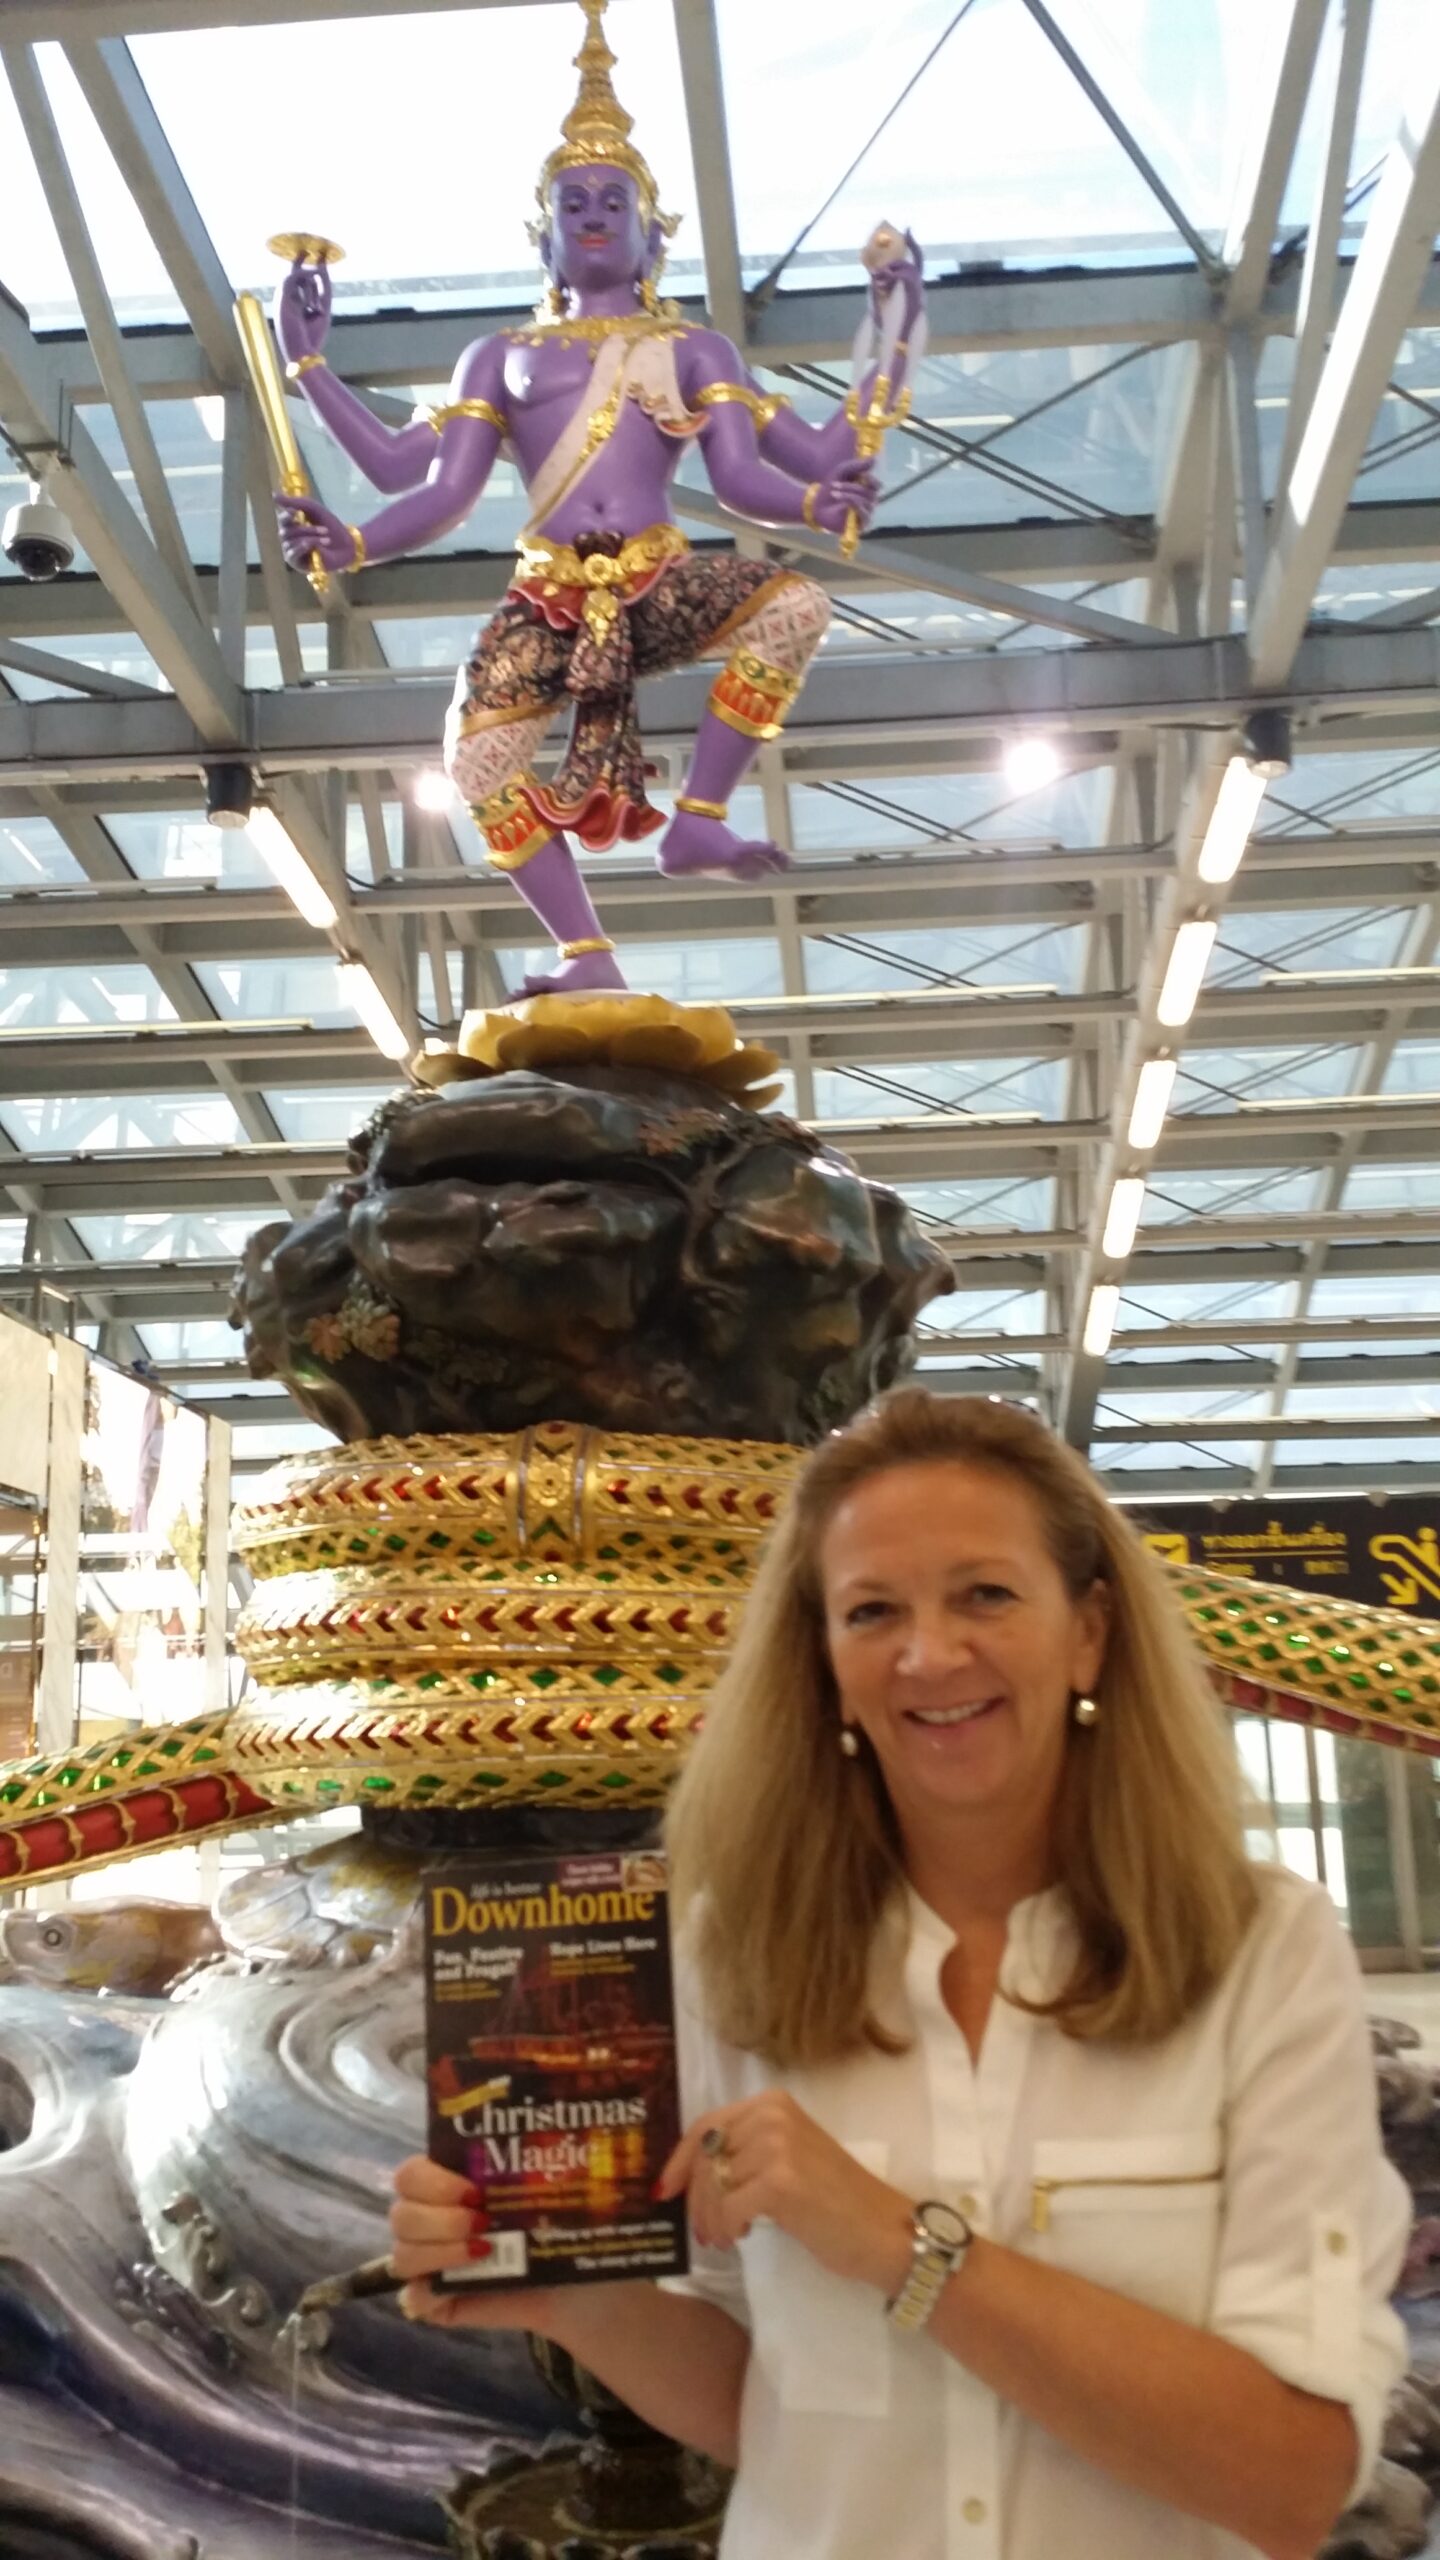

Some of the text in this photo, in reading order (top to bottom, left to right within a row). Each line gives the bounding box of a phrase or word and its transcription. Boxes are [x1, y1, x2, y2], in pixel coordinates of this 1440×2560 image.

[432, 1884, 656, 1937] Downhome
[434, 1966, 462, 1981] and
[452, 2096, 647, 2139] Christmas
[483, 2132, 599, 2183] Magic
